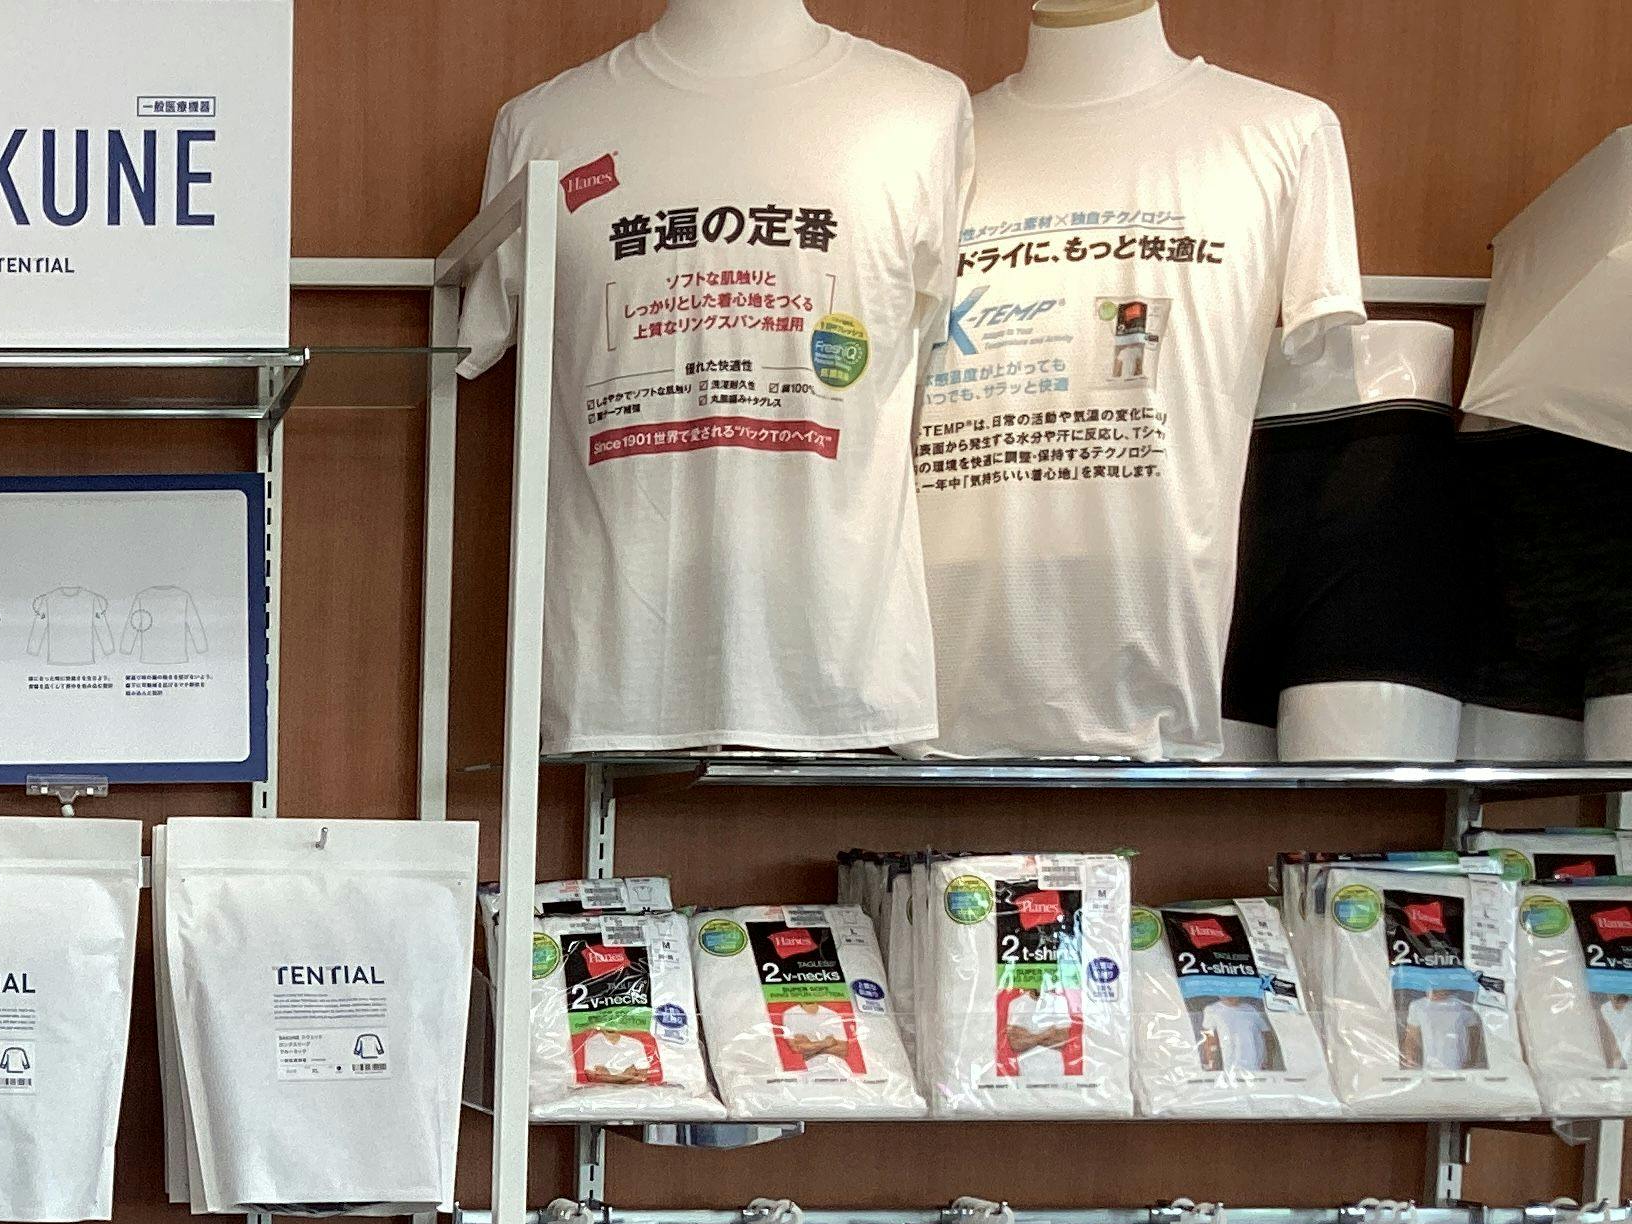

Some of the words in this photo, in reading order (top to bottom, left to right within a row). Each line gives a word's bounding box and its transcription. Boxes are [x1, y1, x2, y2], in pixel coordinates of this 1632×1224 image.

[141, 101, 211, 113] 一般医療機器
[567, 171, 614, 193] Hanes
[609, 204, 838, 261] 普遍の定番
[666, 270, 777, 290] ソフトな肌触りと
[624, 292, 814, 319] しっかりとした着心地をつくる
[633, 315, 805, 340] 上質なリングスパン糸採用
[685, 359, 753, 376] 優れた快適性
[1002, 934, 1020, 961] 2
[1392, 940, 1411, 966] 2
[1587, 944, 1606, 967] 2
[272, 965, 385, 985] TENTIAL
[762, 962, 782, 983] 2
[782, 969, 841, 982] v-necks
[1178, 952, 1199, 974] 2
[1200, 961, 1255, 975] t-shirts
[571, 983, 589, 1009] 2
